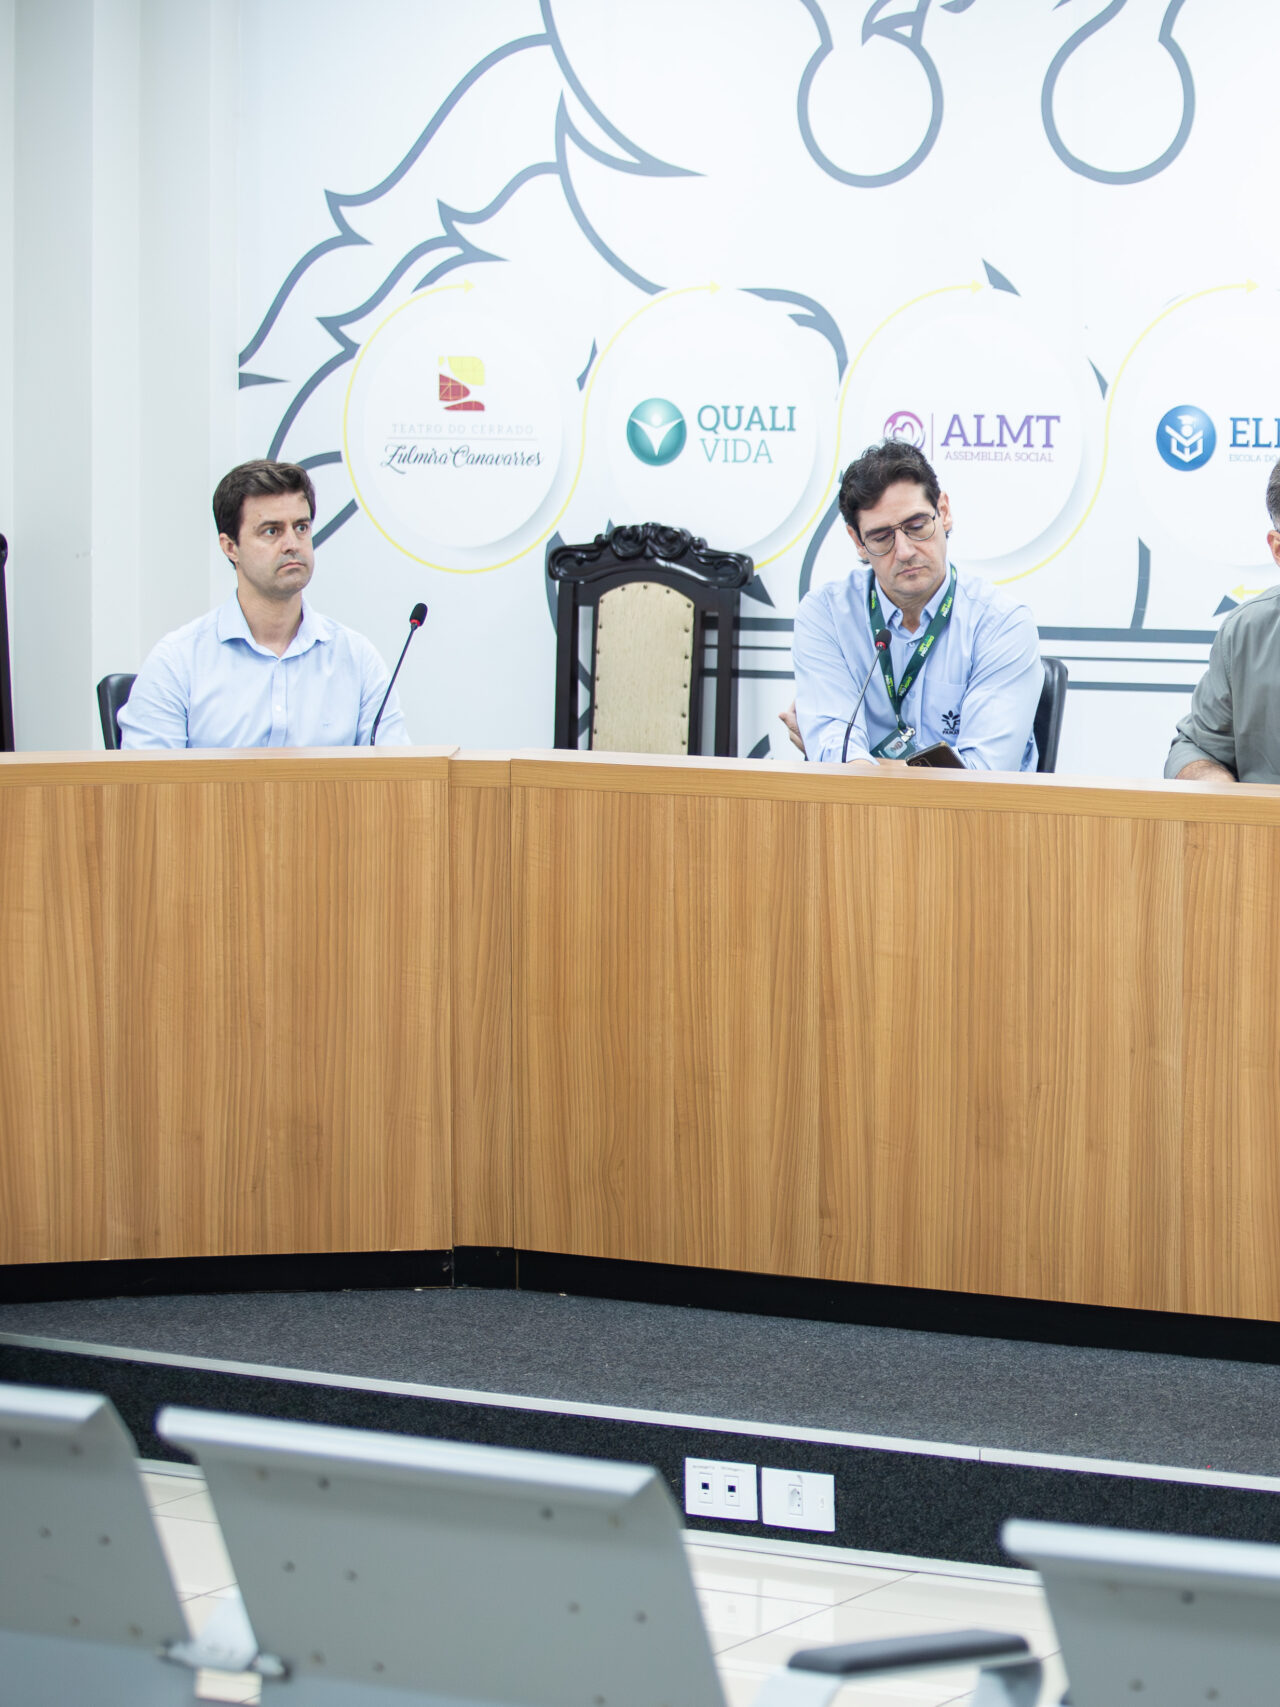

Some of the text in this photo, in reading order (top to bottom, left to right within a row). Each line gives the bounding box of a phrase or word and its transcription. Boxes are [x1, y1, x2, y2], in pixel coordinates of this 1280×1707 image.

[392, 423, 534, 436] TEATRO DO CERRADO
[696, 404, 797, 434] QUALI
[940, 414, 1061, 448] ALMT
[380, 444, 448, 475] Zulmira
[699, 438, 774, 464] VIDA
[944, 450, 1055, 463] ASSEMBLEIA SOCIAL
[1229, 454, 1262, 463] ESCOLA
